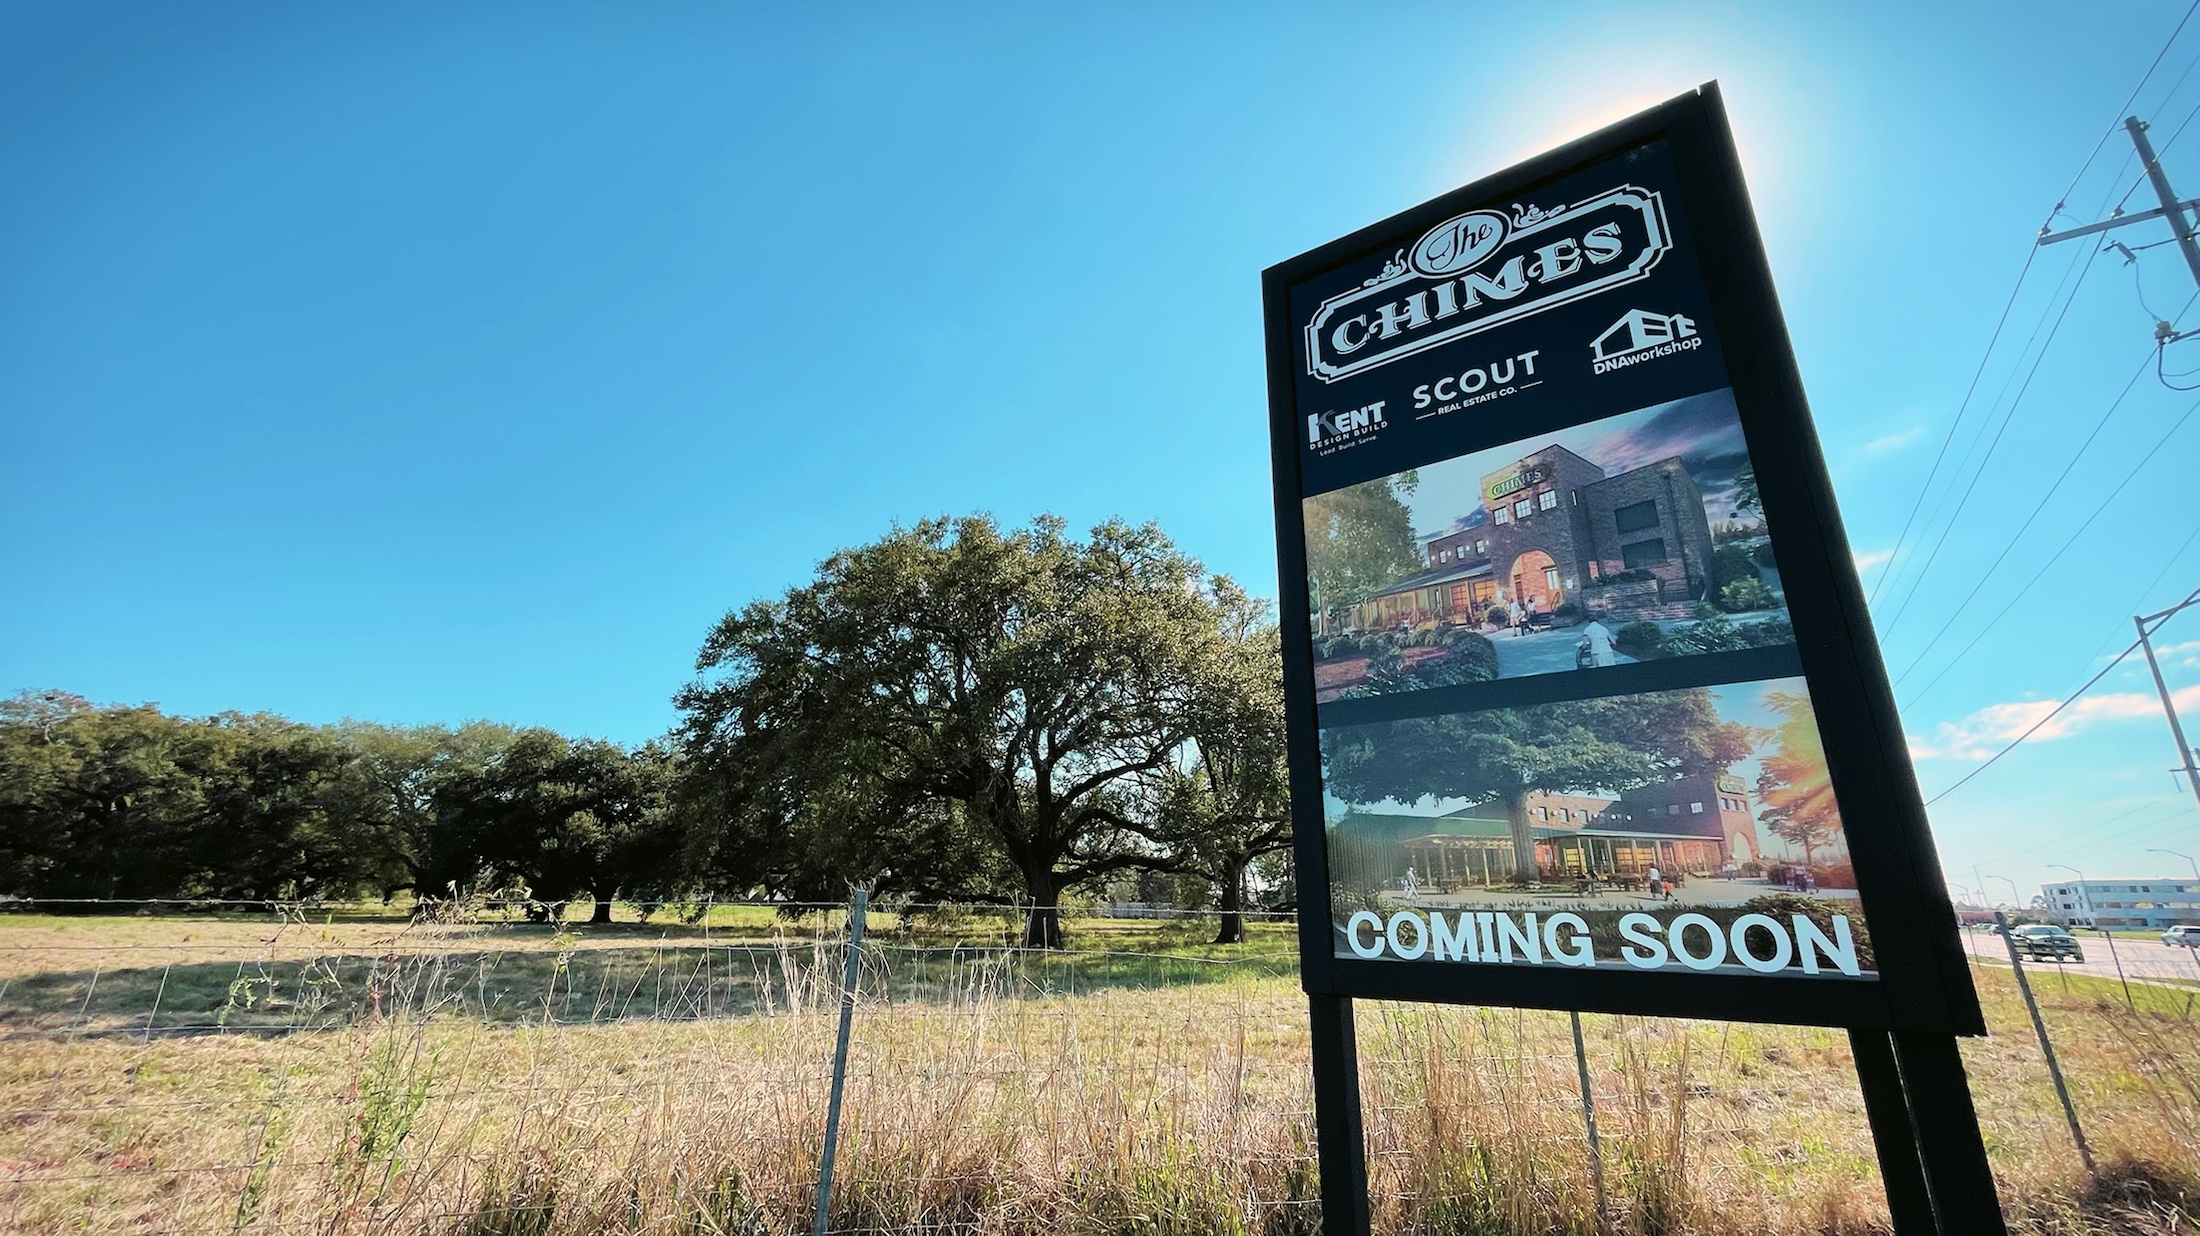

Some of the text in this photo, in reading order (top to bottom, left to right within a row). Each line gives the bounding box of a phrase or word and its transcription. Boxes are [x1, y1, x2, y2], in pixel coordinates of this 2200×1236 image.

[1426, 222, 1493, 271] The
[1331, 221, 1624, 355] CHIMES
[1594, 337, 1702, 375] DNAworkshop
[1413, 350, 1539, 409] SCOUT
[1437, 386, 1518, 415] REAL ESTATE CO.
[1307, 400, 1386, 443] KENT
[1309, 420, 1388, 451] DESIGN BUILD
[1347, 911, 1862, 976] COMING SOON
